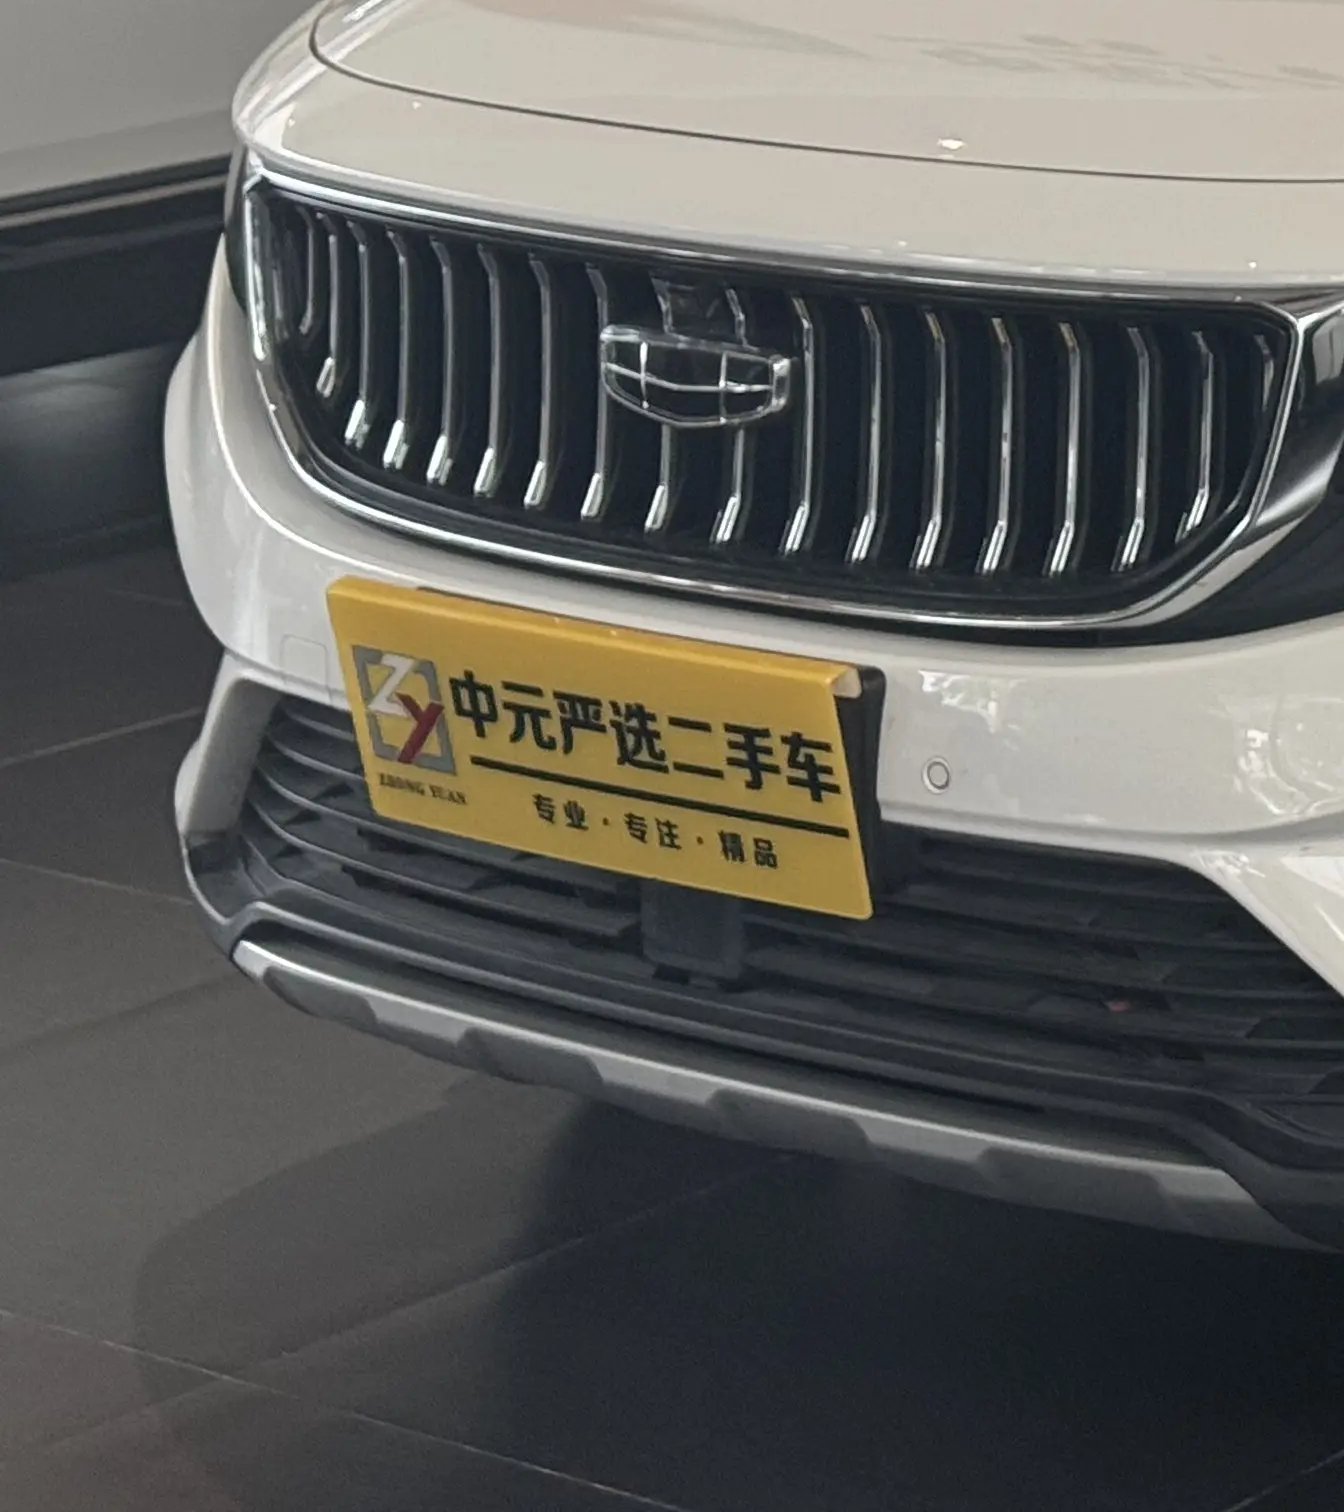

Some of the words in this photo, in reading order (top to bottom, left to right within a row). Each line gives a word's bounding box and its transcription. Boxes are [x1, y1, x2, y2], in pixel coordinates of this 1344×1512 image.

[448, 669, 843, 804] 中元严选二手车
